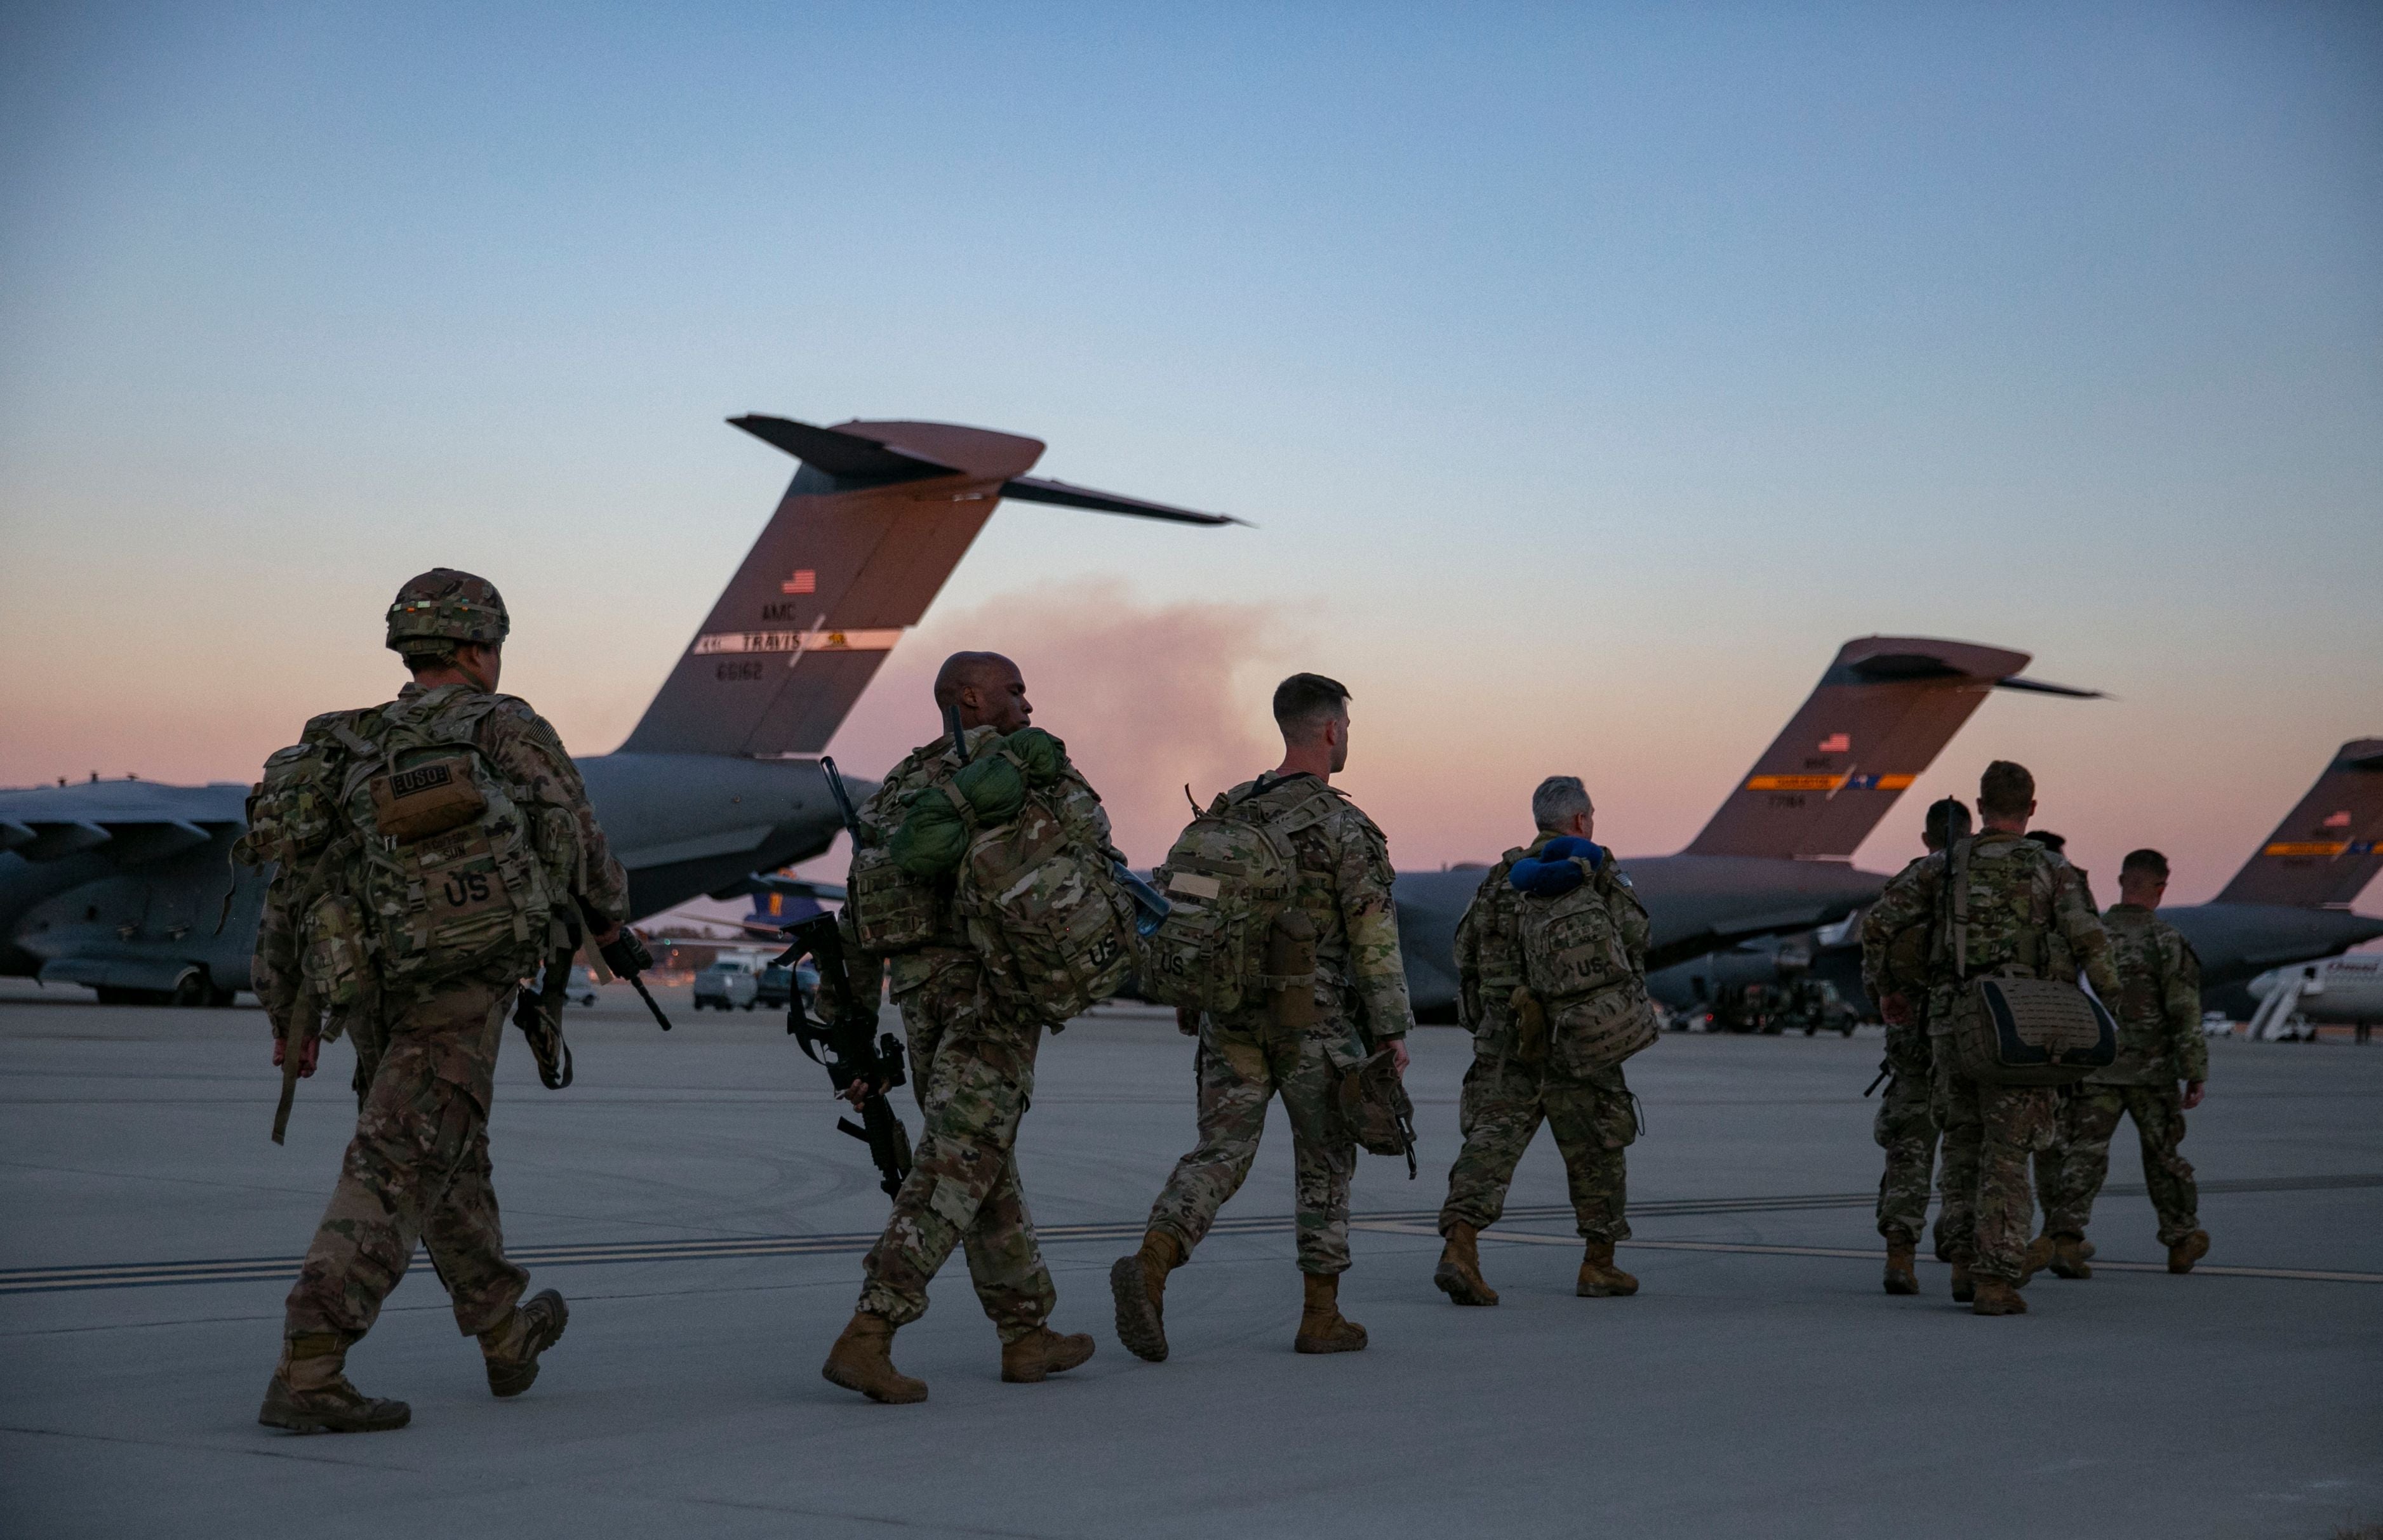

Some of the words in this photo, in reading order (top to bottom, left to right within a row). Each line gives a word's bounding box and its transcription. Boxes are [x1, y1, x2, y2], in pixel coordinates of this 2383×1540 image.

[743, 634, 801, 652] TRAVIS
[403, 769, 439, 790] USO
[443, 845, 467, 861] SUN
[444, 873, 491, 907] US
[1088, 931, 1118, 966] US
[1161, 952, 1184, 976] US
[1576, 956, 1604, 977] US
